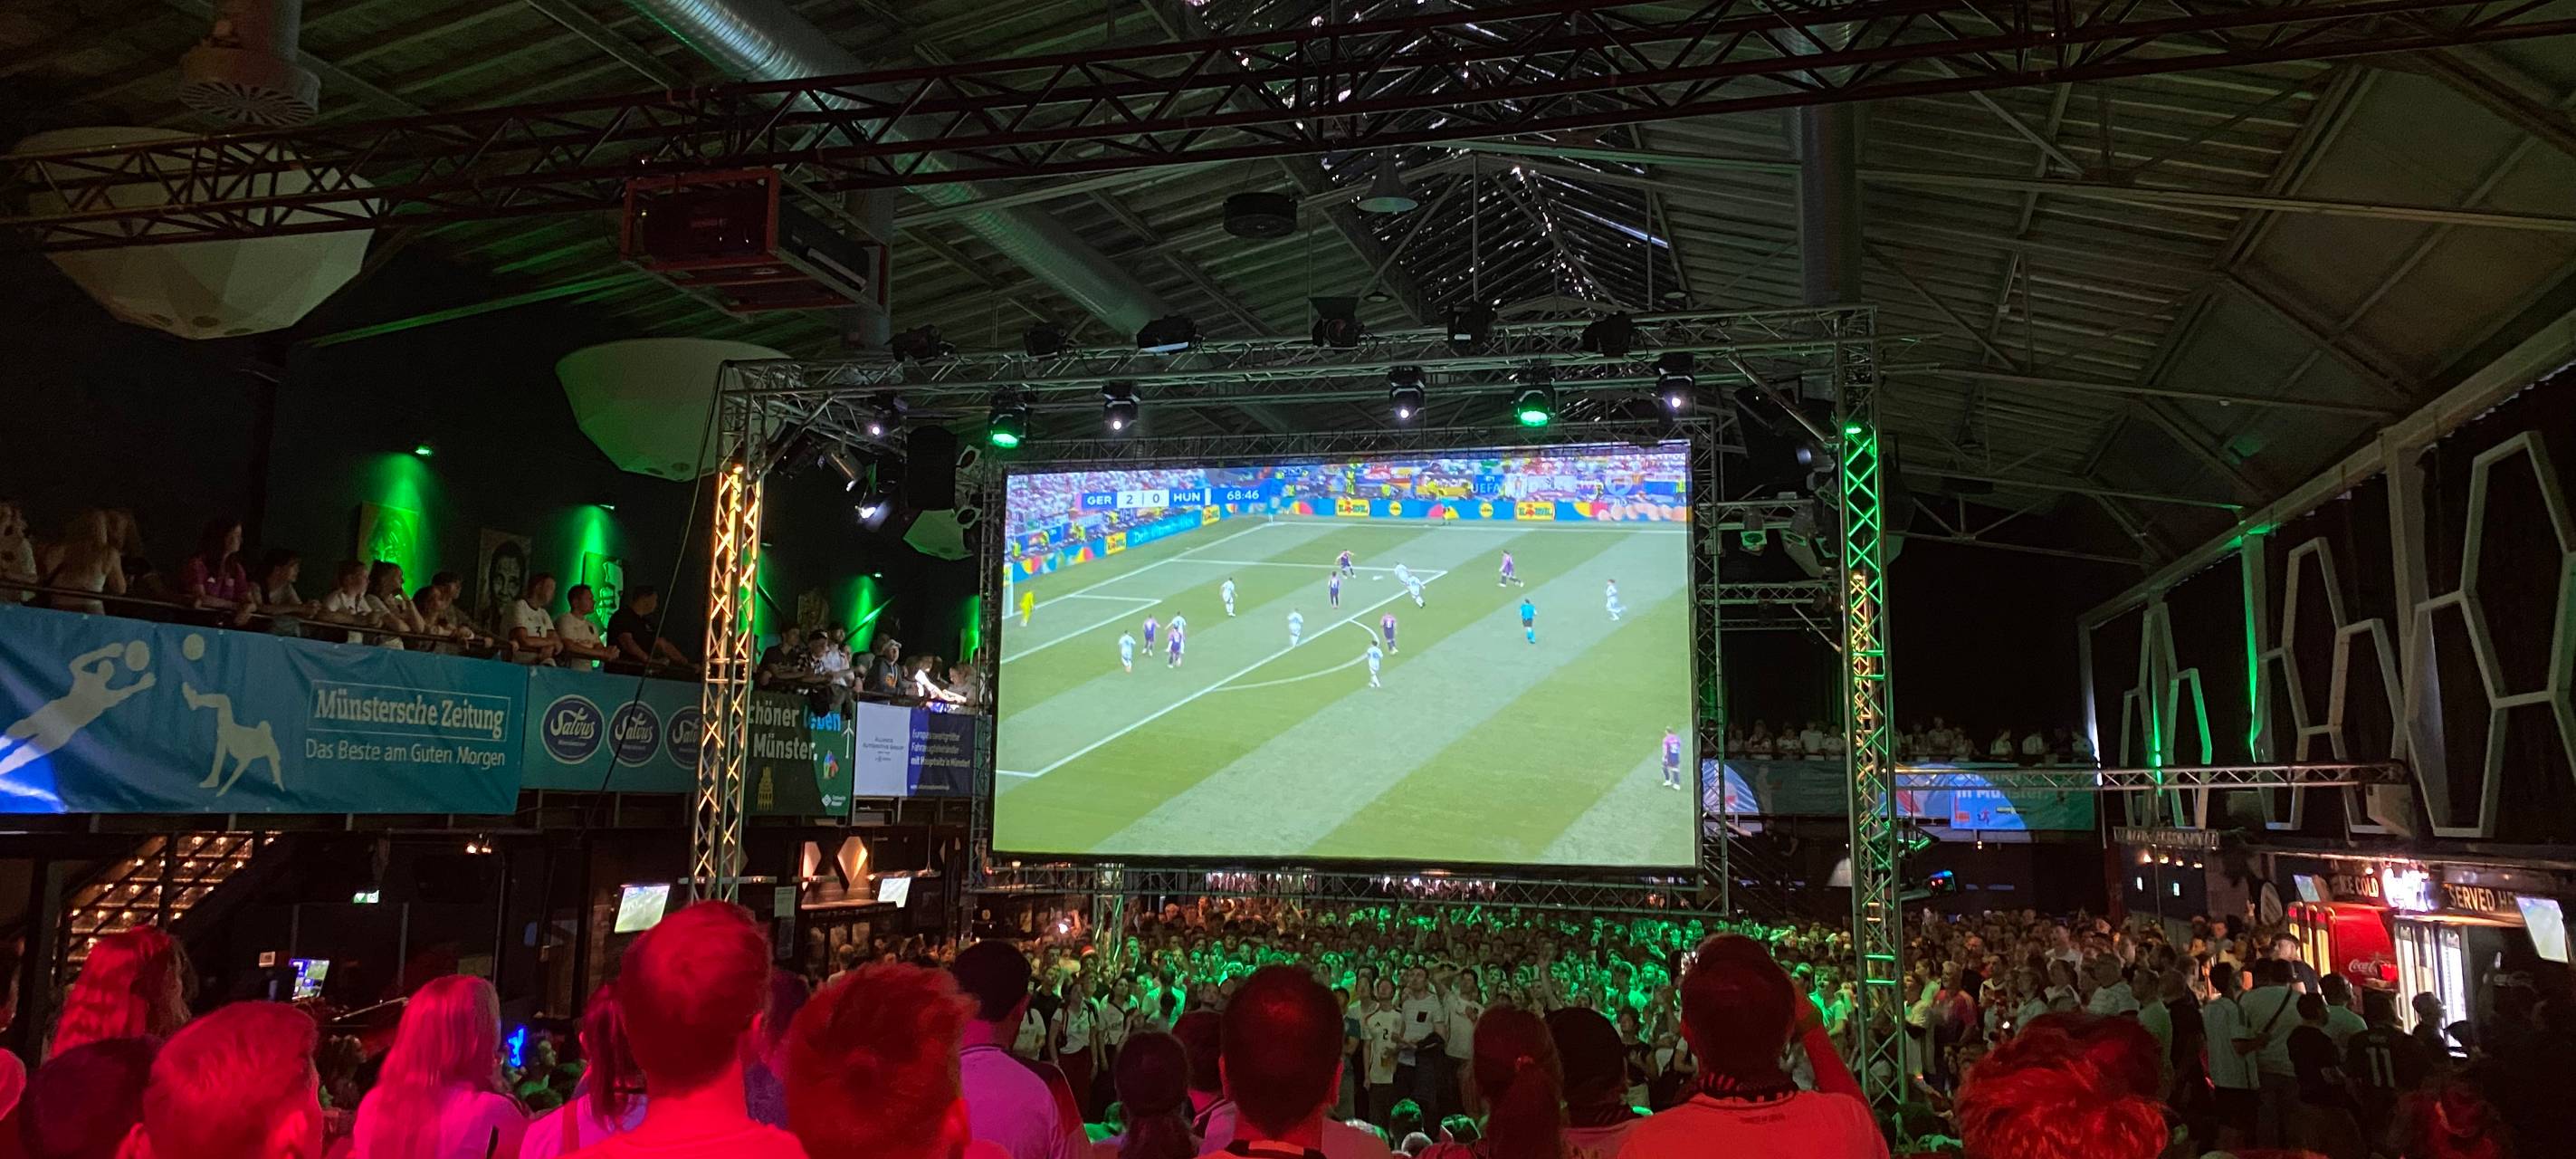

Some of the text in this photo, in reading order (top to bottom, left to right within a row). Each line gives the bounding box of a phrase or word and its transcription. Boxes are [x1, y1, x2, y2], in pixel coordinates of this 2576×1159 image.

[1087, 490, 1260, 506] GER 2 0 HUN 68:46
[314, 687, 505, 739] Münstersche Zeitung
[550, 707, 596, 739] Salvus
[748, 700, 800, 728] chöner
[615, 713, 654, 743] Salvus
[305, 738, 505, 771] Das Beste am Guten Morgen
[753, 733, 818, 761] Münster.
[2355, 876, 2380, 898] COLD
[2447, 885, 2495, 912] SERVED
